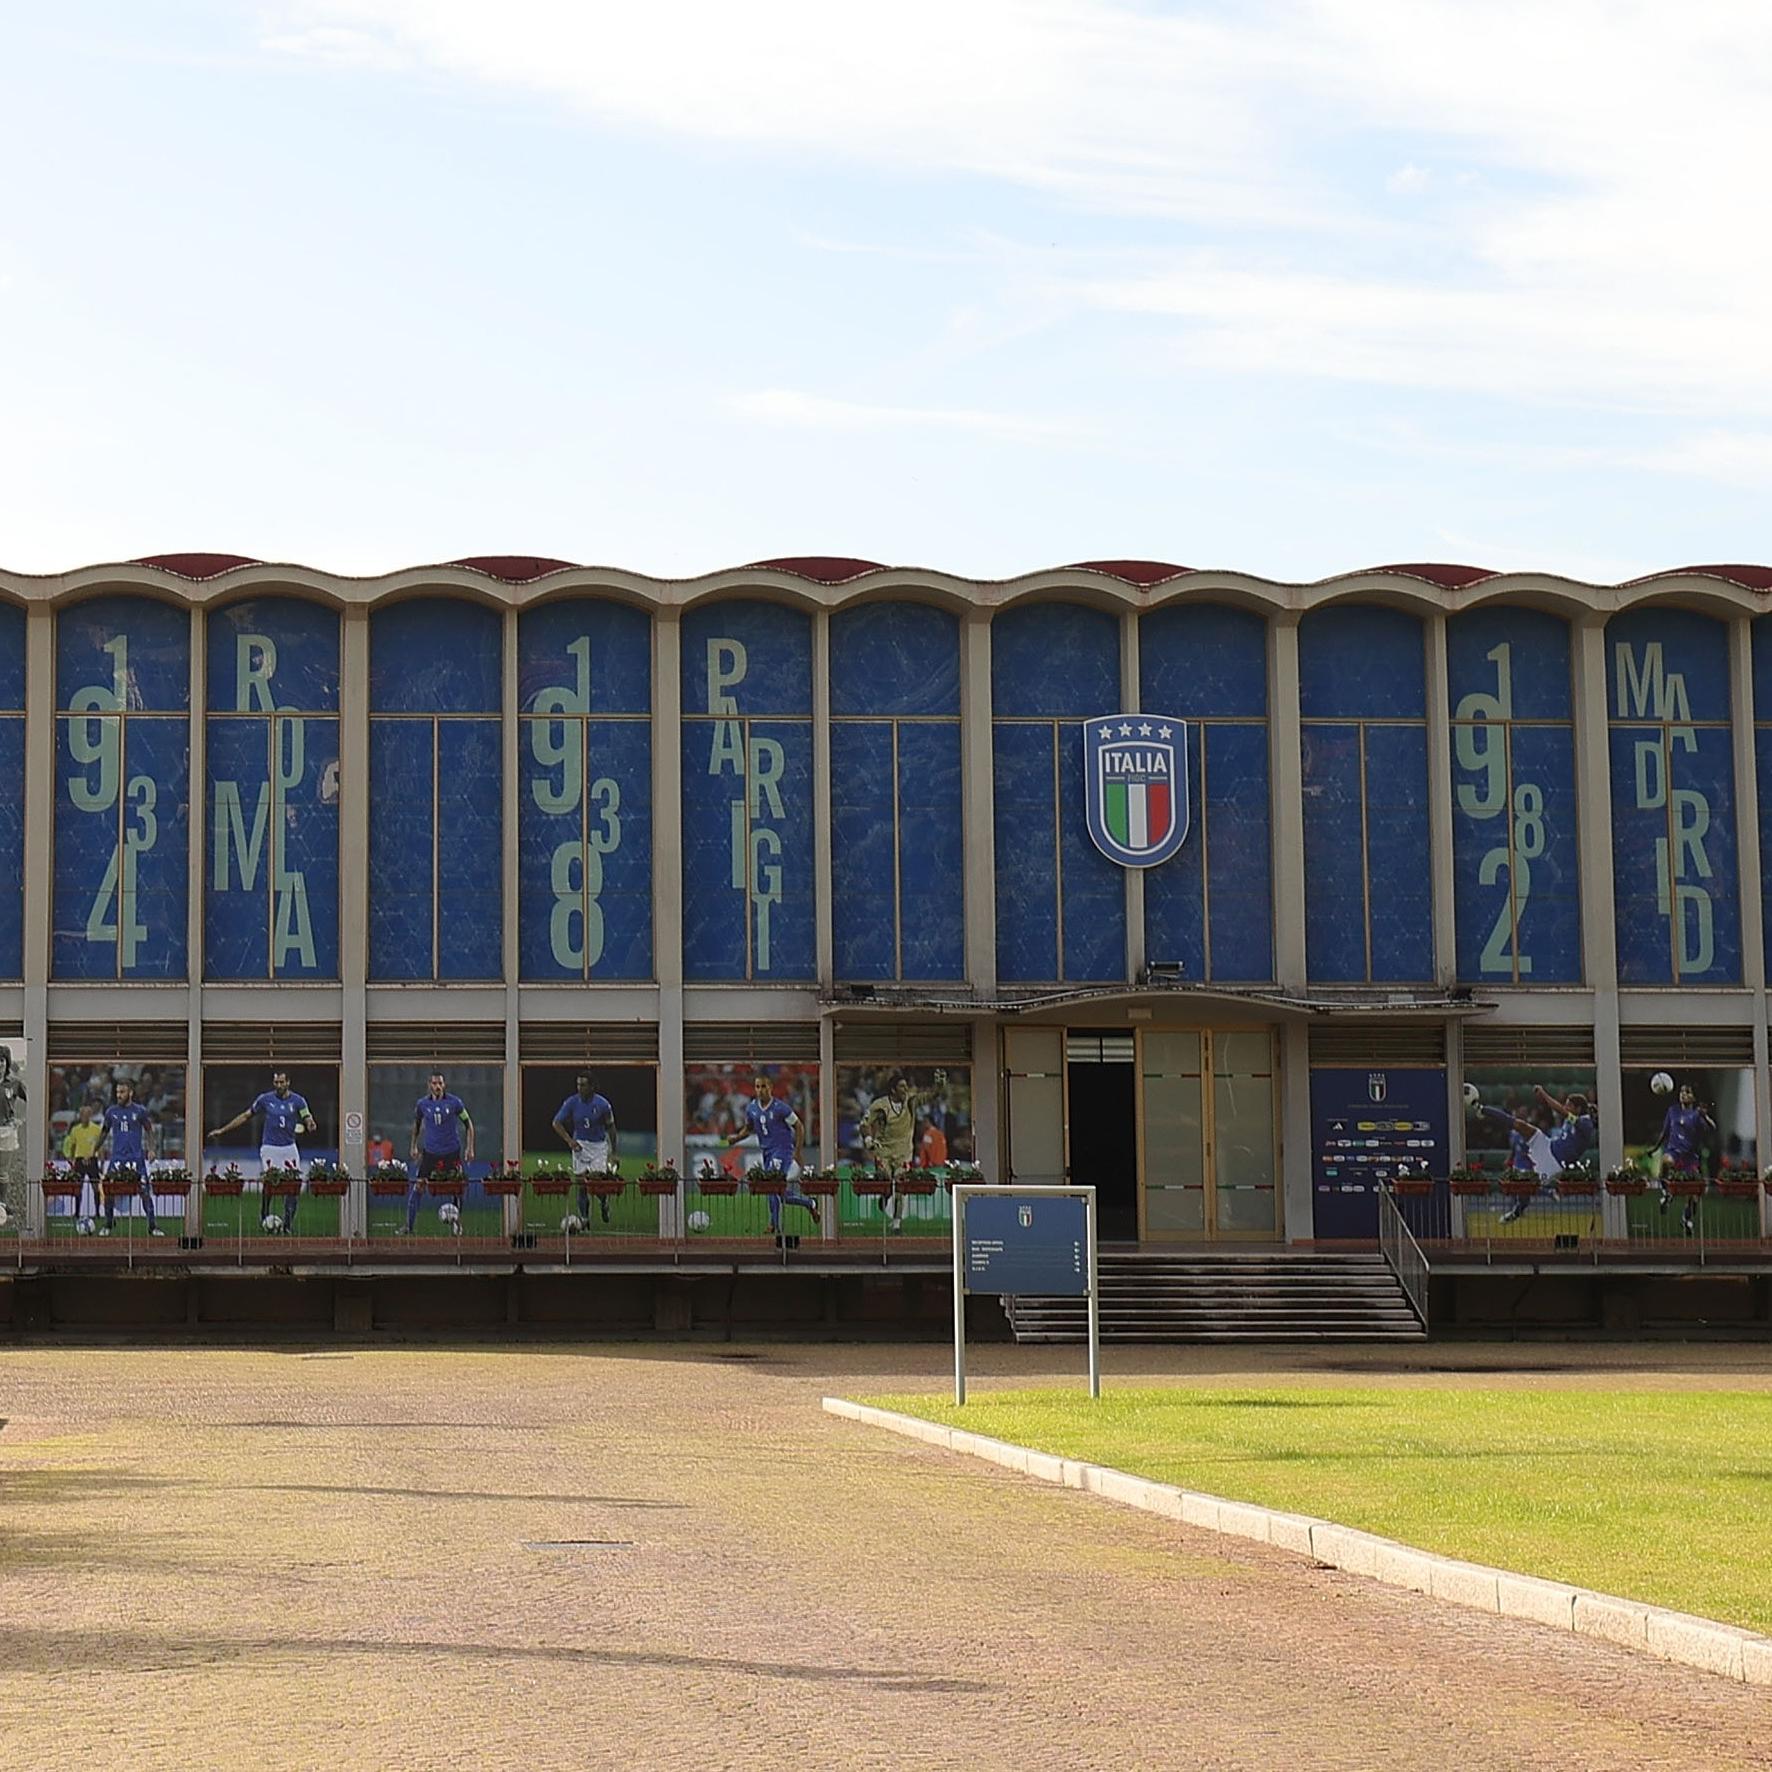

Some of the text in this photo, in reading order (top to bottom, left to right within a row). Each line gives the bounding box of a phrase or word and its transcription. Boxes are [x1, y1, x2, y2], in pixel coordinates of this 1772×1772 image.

[1105, 752, 1167, 773] ITALIA
[279, 1115, 286, 1128] 3
[584, 1117, 590, 1129] 3
